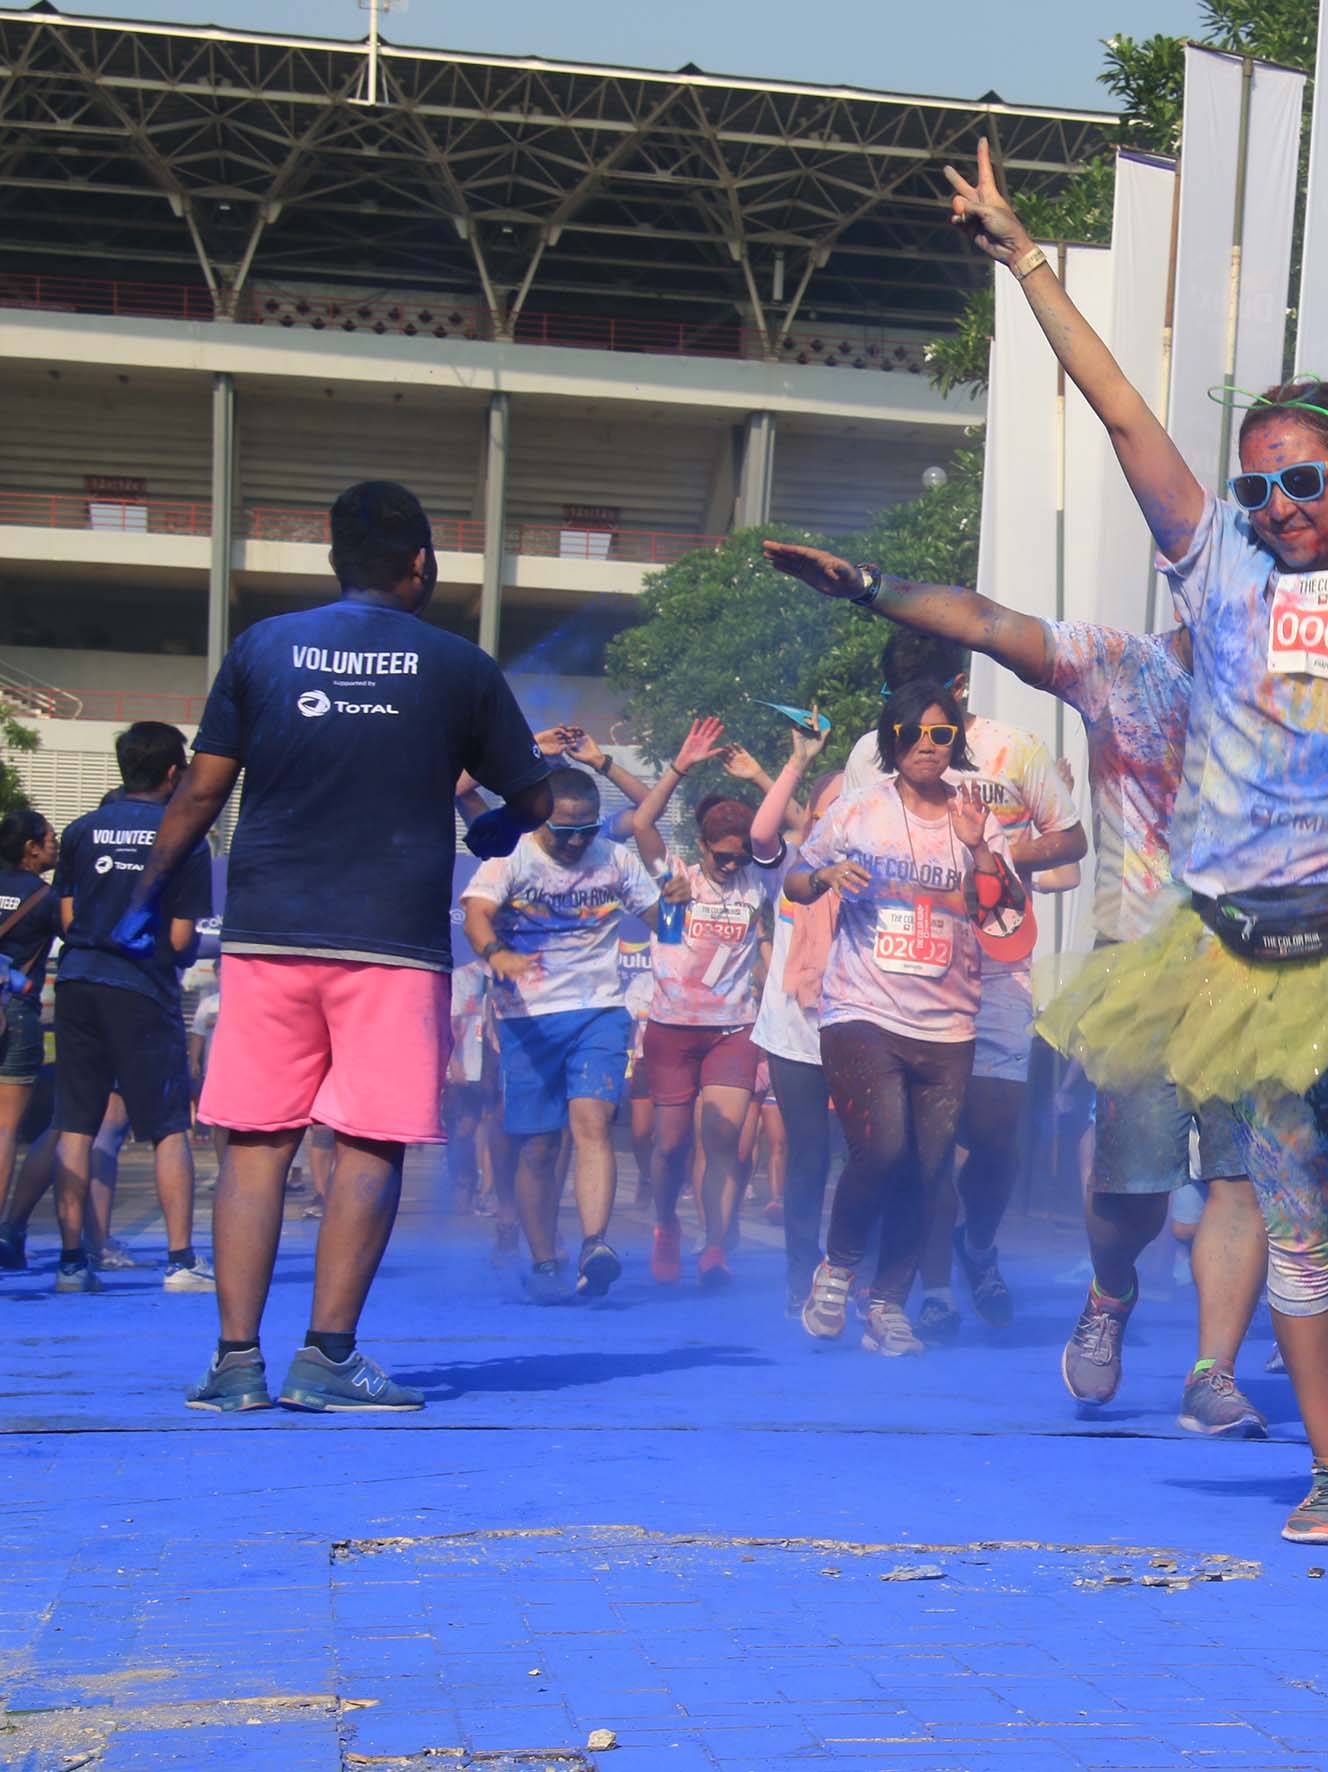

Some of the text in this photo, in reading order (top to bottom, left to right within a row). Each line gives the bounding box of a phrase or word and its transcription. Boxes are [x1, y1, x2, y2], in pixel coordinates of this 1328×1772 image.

[1300, 580, 1316, 593] THE
[293, 645, 419, 675] VOLUNTEER
[334, 701, 399, 714] TOTAL
[93, 829, 157, 846] VOLUNTEE
[886, 858, 943, 887] COLOR
